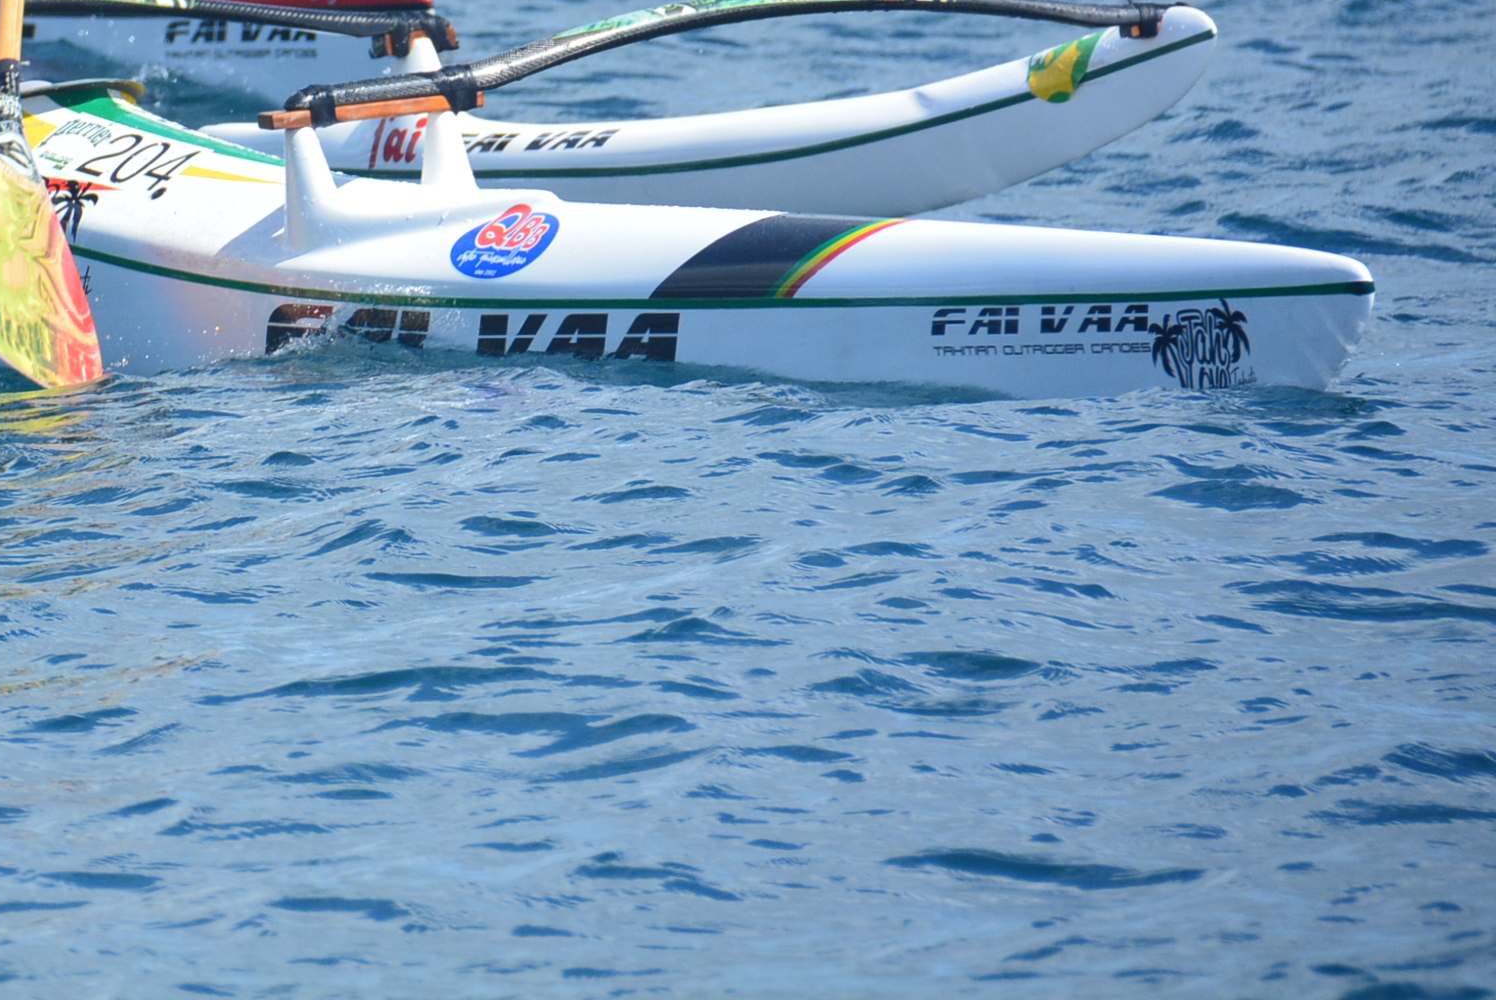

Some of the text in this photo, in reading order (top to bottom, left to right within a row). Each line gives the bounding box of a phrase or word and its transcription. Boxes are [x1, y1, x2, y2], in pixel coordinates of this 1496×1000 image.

[164, 19, 229, 44] FAI
[523, 128, 622, 151] VAA
[75, 133, 202, 192] 204
[931, 304, 1149, 336] FAI VAA
[475, 312, 681, 362] VAA
[933, 342, 1152, 356] TAHITIAN OUTRIGGER CANOES
